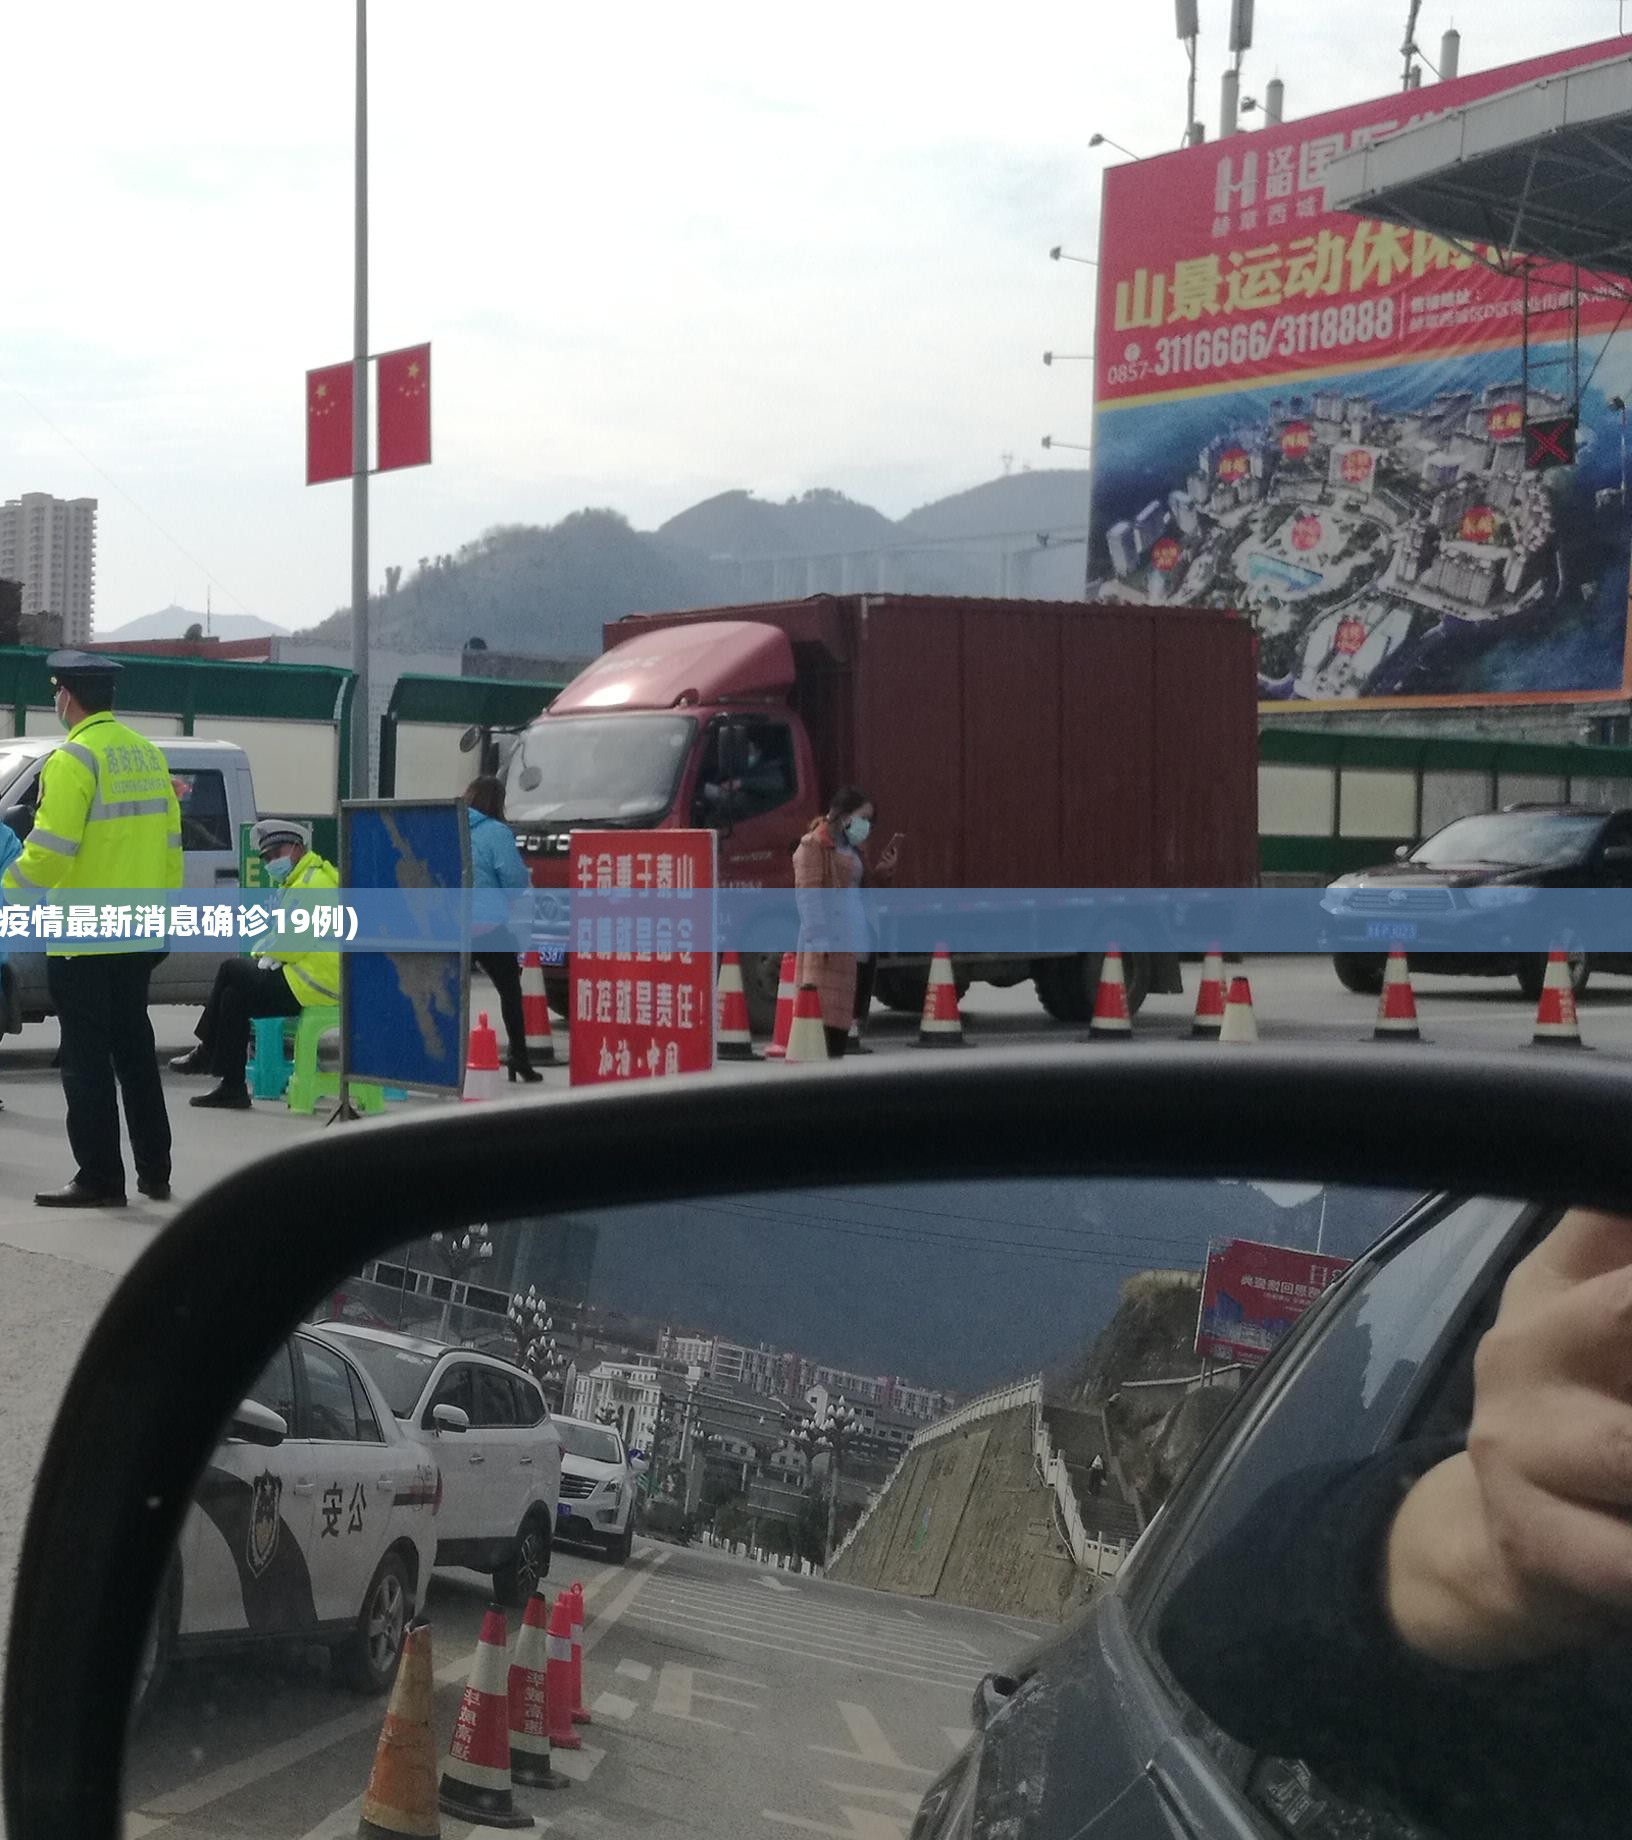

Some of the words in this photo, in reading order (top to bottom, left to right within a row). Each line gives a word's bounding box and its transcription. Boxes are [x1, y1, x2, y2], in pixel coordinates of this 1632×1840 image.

[515, 834, 572, 851] FOTO
[577, 853, 693, 898] 生命重于泰山
